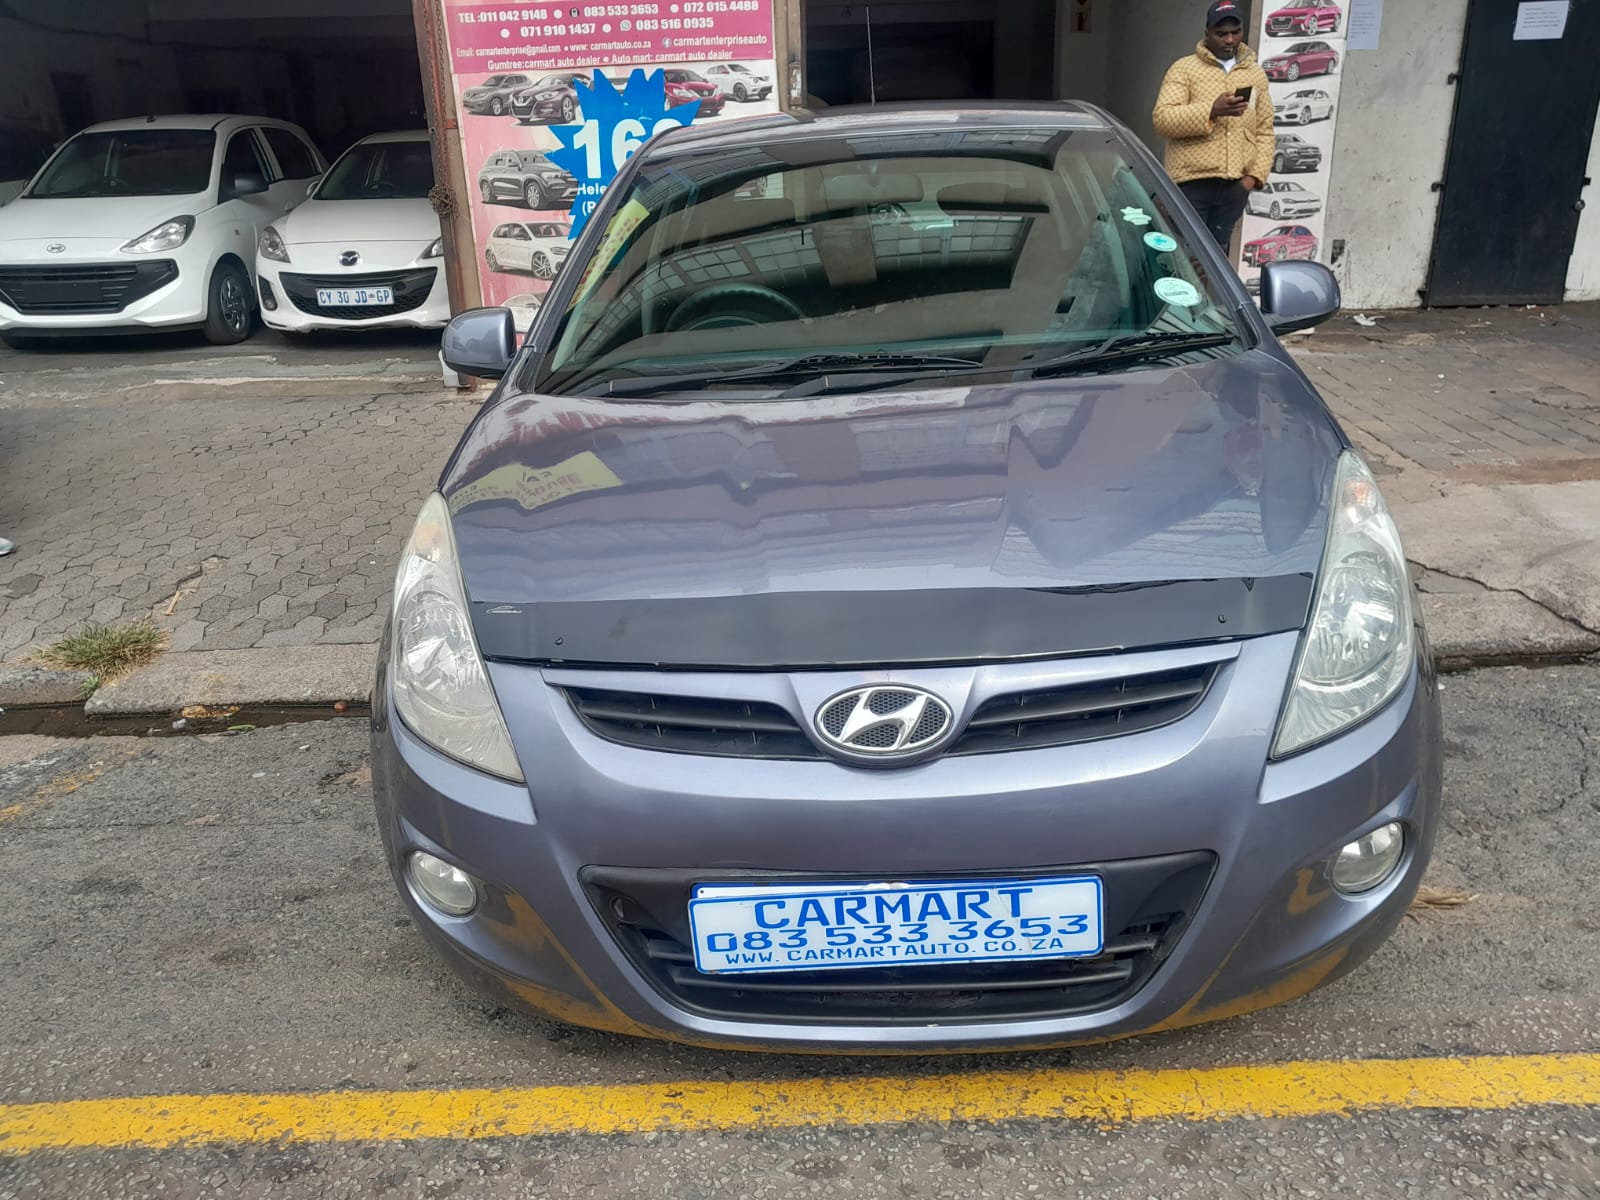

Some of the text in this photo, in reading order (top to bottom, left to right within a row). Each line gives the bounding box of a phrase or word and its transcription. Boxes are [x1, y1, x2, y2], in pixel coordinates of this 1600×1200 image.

[584, 4, 659, 17] 083 533 3653
[683, 2, 704, 13] 072
[499, 10, 520, 21] 042
[521, 9, 548, 20] 9148
[520, 23, 596, 37] 071 910 1437
[636, 17, 714, 31] 083 516 0935
[673, 34, 767, 47] carmartenterpriseauto
[557, 56, 575, 67] auto
[577, 55, 601, 66] dealer
[612, 54, 629, 64] Auto
[655, 52, 686, 62] carmart
[687, 51, 706, 61] auto
[708, 50, 733, 60] dealer
[319, 290, 389, 304] CY 30 JD GP
[754, 888, 1033, 929] CARMART
[706, 915, 1089, 952] 083 533 3653
